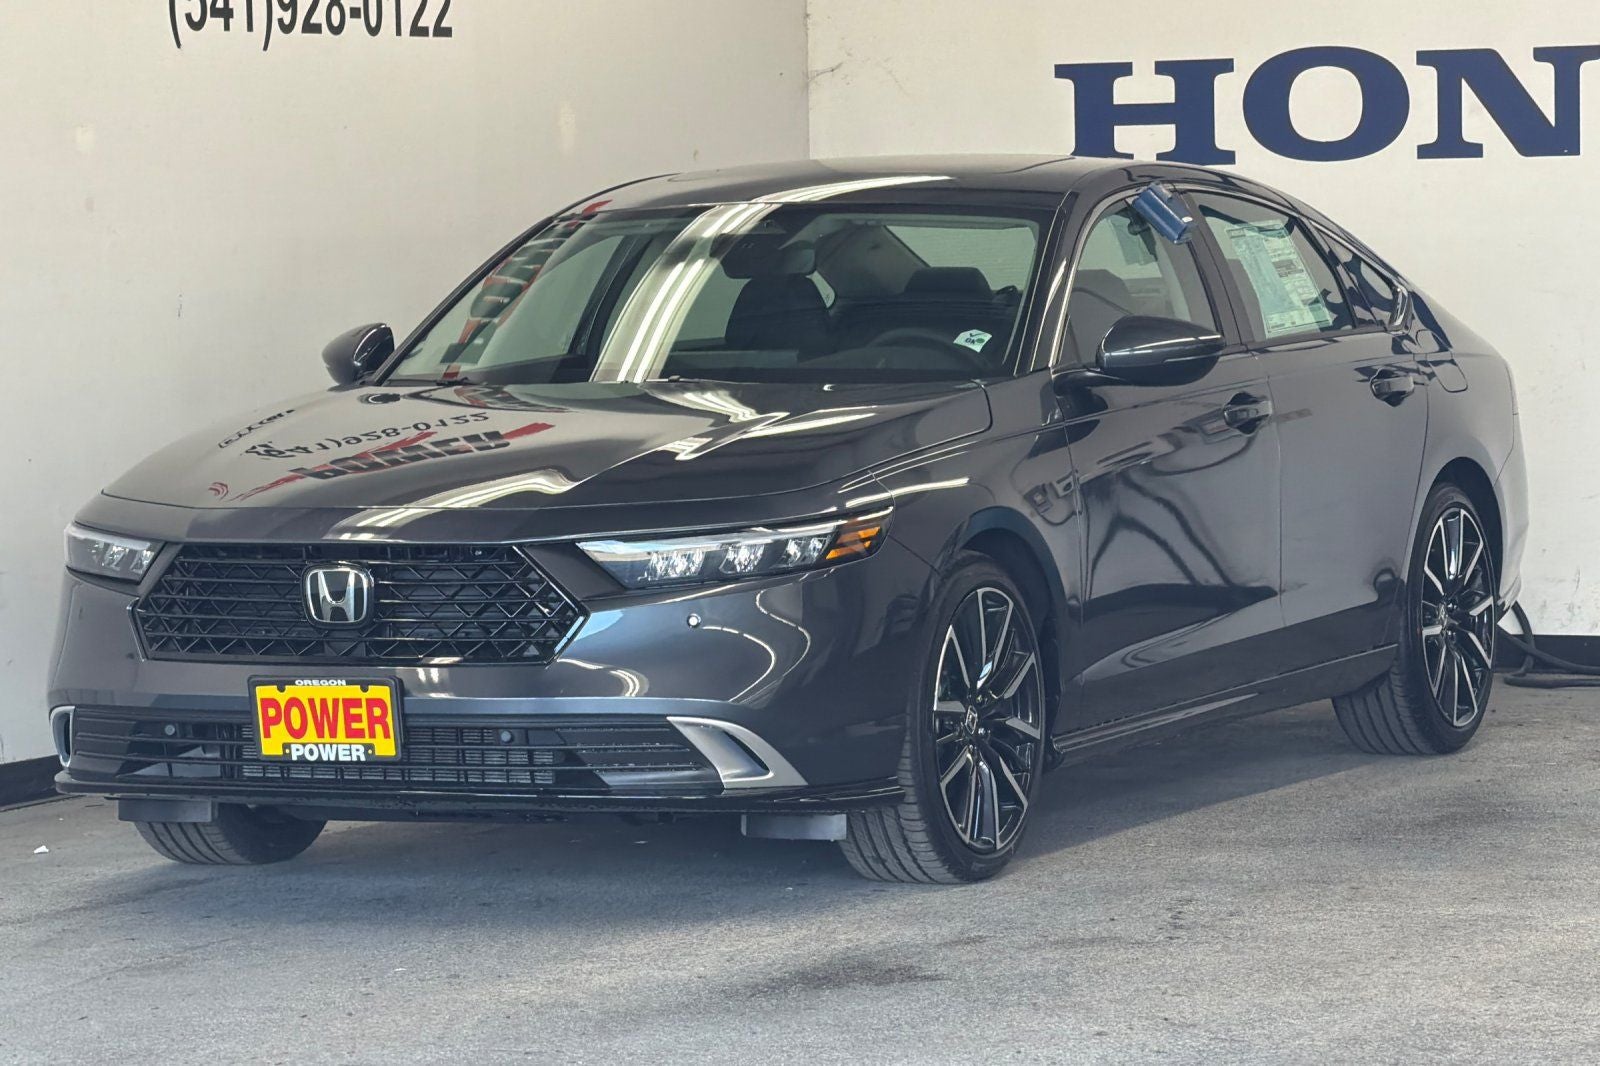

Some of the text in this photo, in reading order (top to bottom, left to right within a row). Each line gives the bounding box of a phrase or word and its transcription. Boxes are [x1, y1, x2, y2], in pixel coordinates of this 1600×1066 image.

[1054, 45, 1600, 165] HON
[294, 679, 347, 687] OREGON
[260, 697, 391, 739] POWER
[290, 743, 366, 761] POWER
